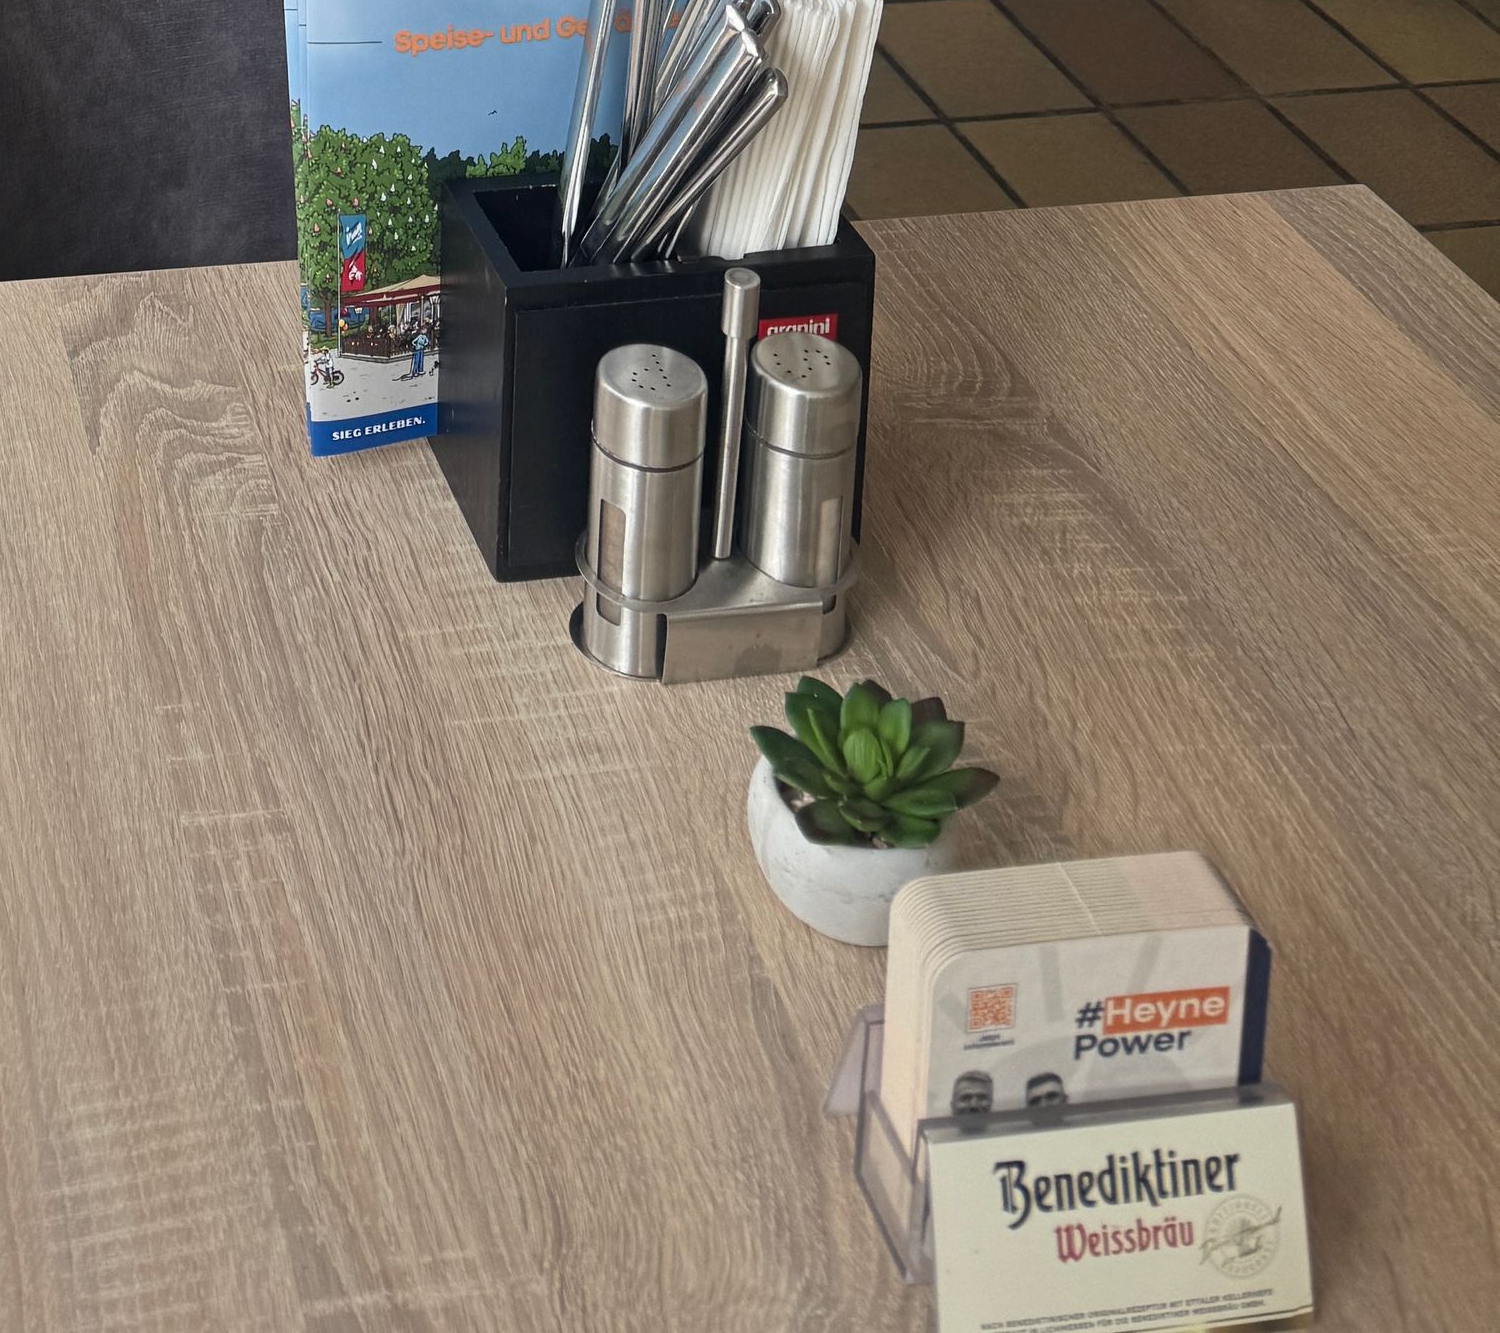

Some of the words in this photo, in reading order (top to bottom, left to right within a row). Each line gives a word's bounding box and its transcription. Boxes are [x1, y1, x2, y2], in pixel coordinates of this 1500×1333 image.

[394, 24, 494, 58] Speise-
[500, 17, 550, 44] und
[332, 428, 362, 441] SIEG
[364, 417, 426, 436] ERLEBEN.
[1075, 995, 1226, 1029] #Heyne
[1074, 1030, 1193, 1061] Power
[992, 1148, 1241, 1230] Benediktiner
[1053, 1217, 1195, 1264] Weissbräu
